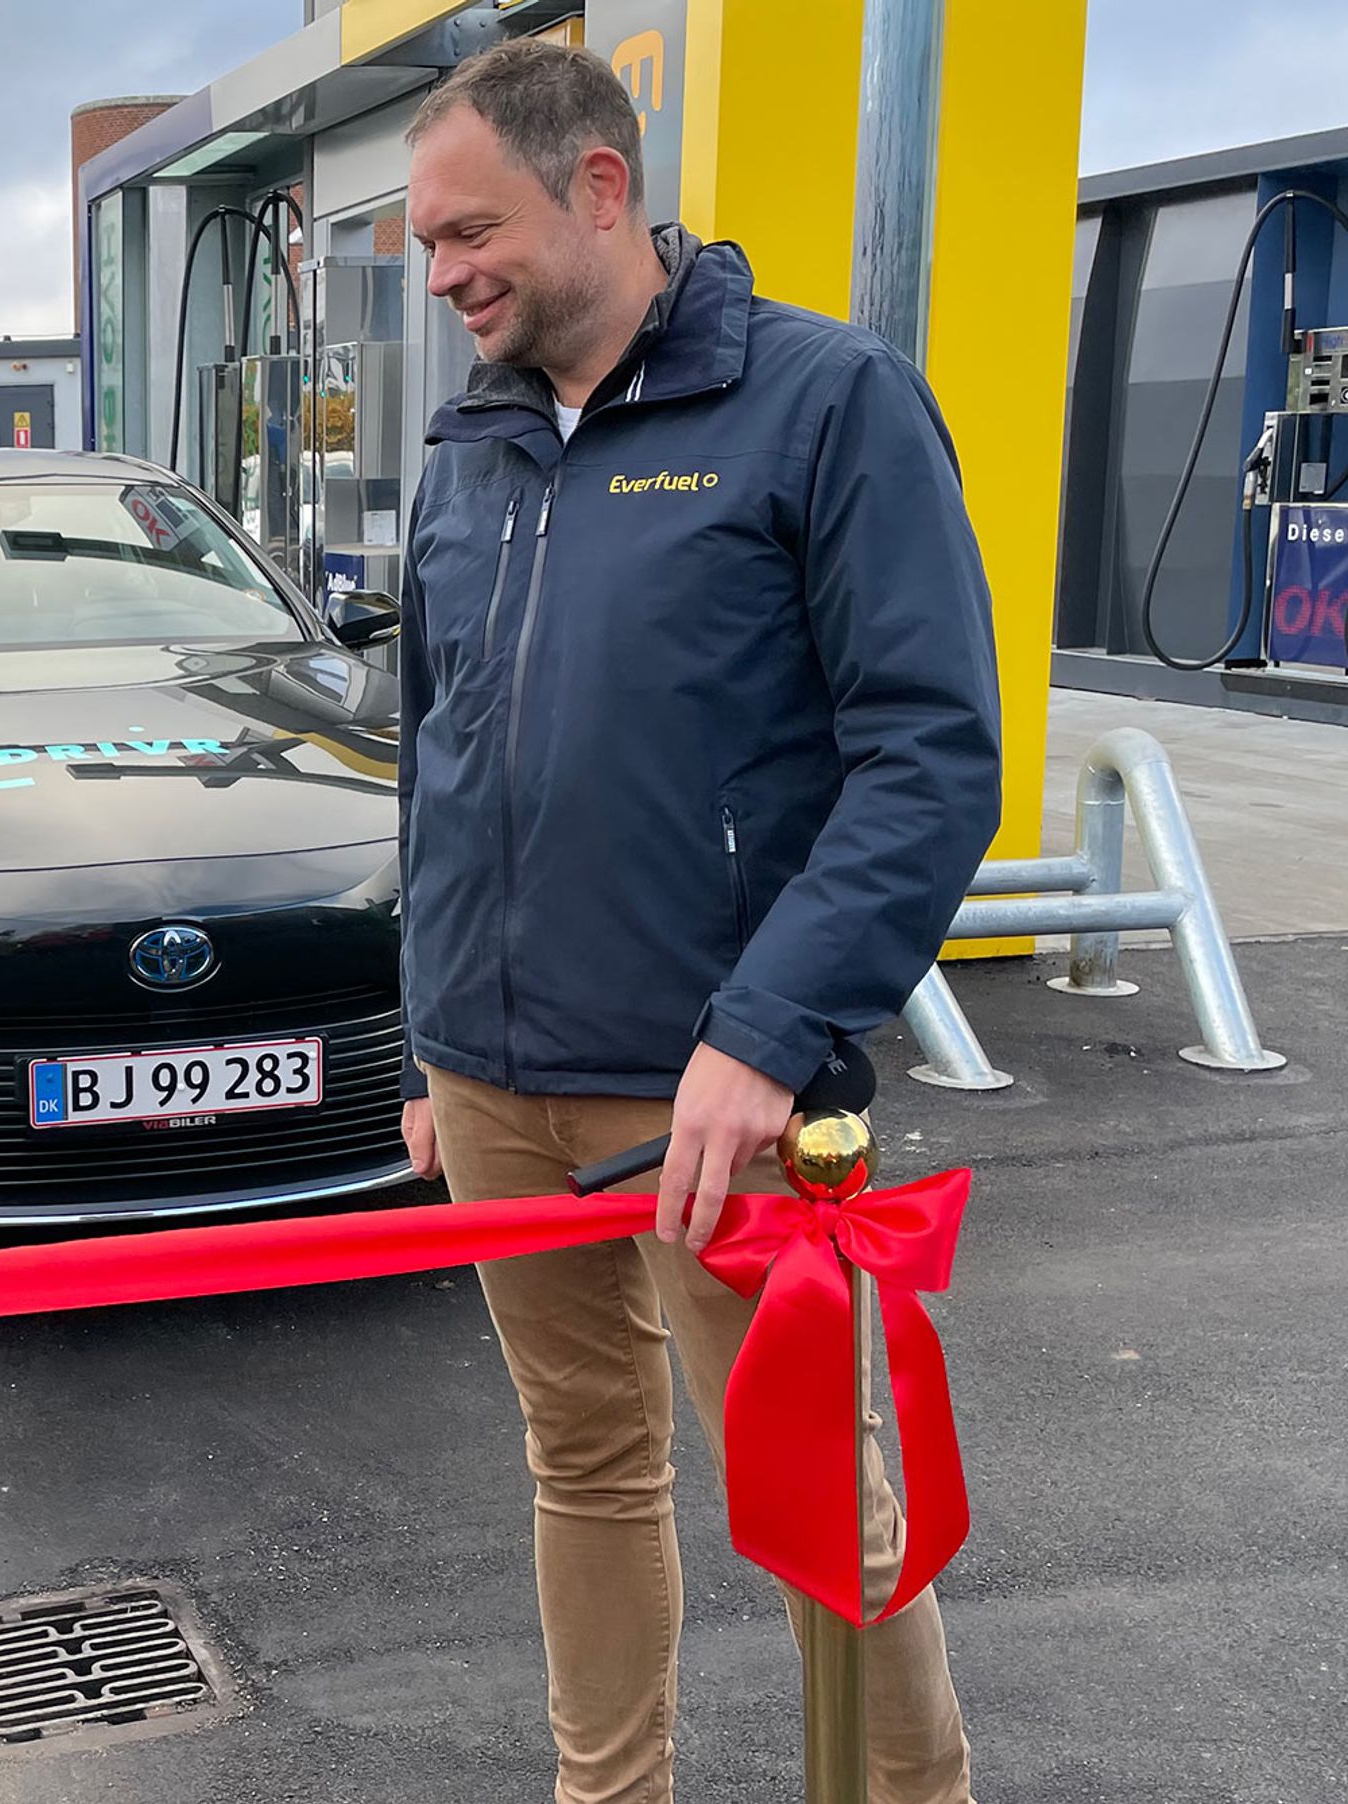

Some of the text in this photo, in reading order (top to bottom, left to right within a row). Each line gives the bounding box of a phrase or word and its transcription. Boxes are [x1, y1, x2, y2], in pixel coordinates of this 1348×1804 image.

[608, 471, 700, 494] Everfuel
[1286, 523, 1345, 543] Diese
[1274, 584, 1348, 639] OK
[38, 1098, 60, 1114] DK
[151, 1059, 211, 1108] 99
[224, 1050, 312, 1101] 283
